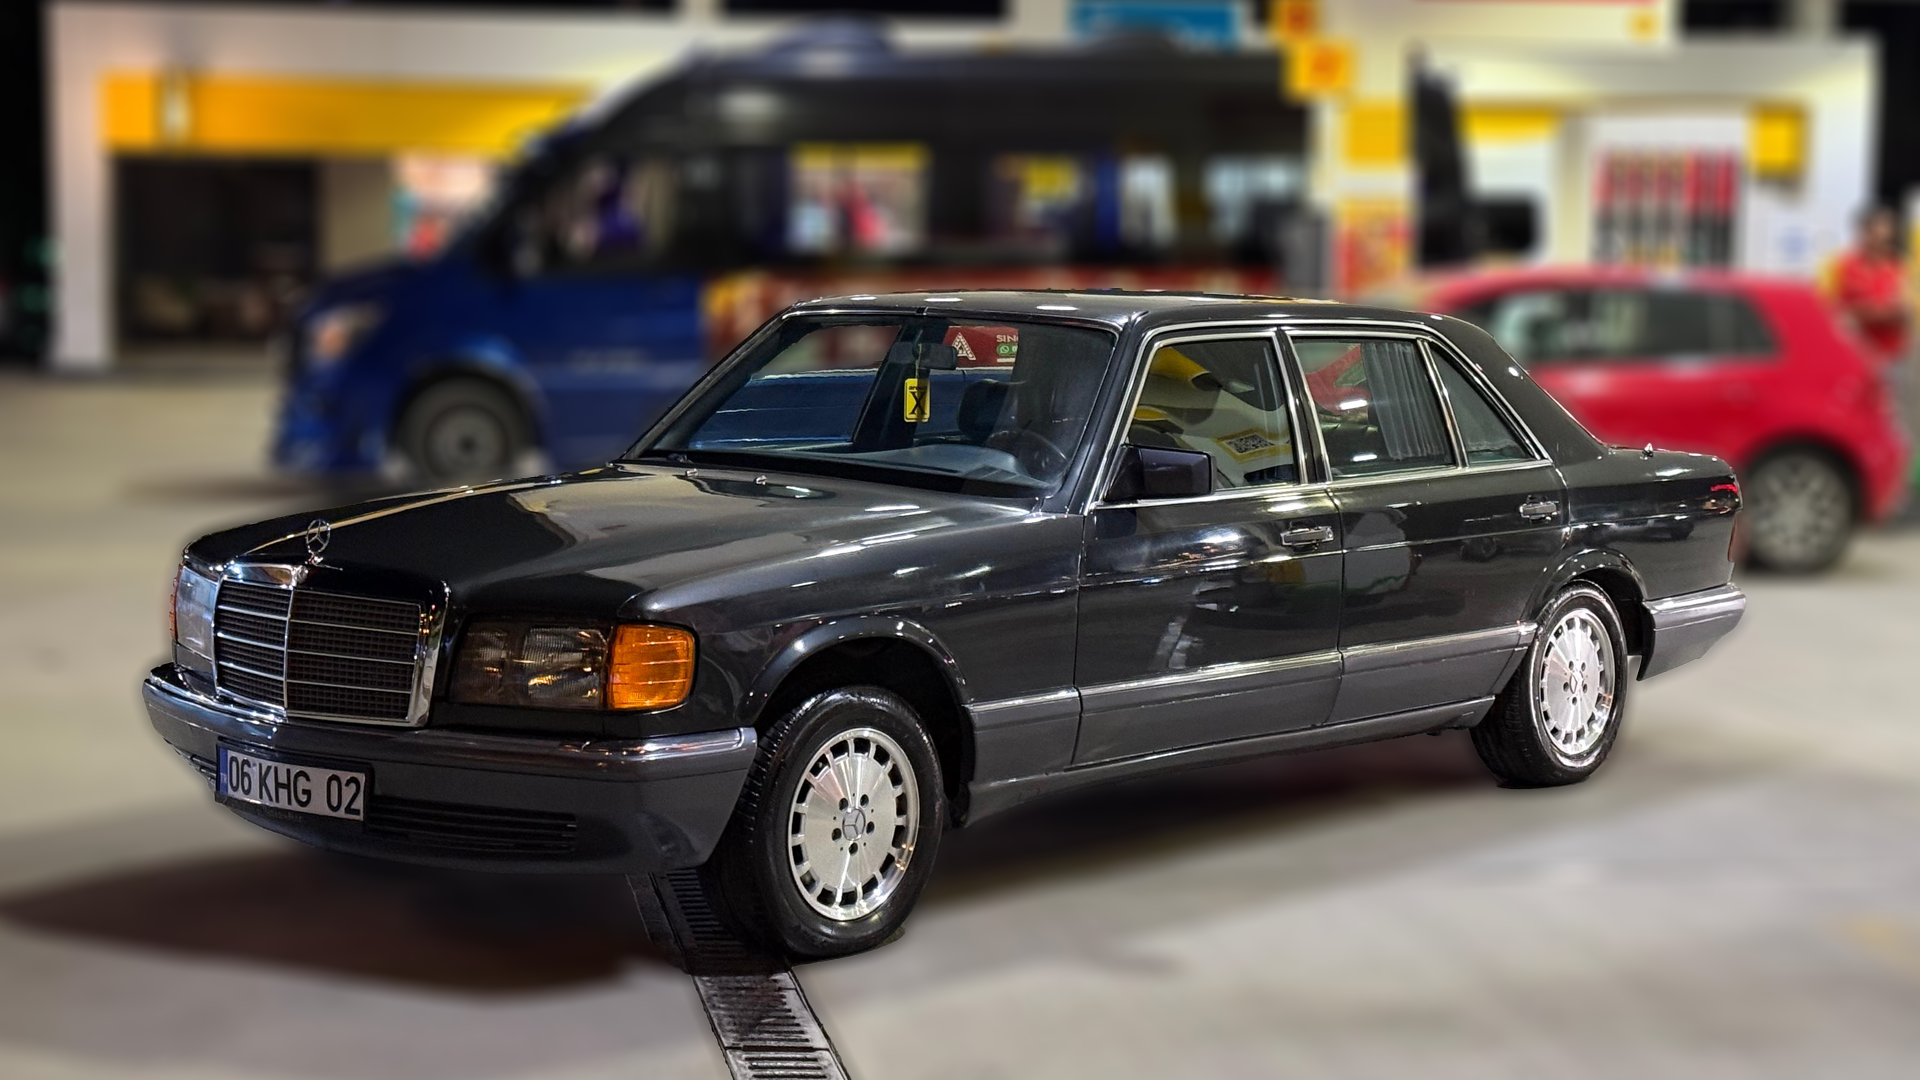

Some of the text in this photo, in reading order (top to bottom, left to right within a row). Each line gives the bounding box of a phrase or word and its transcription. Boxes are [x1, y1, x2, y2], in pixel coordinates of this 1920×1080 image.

[996, 335, 1018, 343] SIN
[909, 391, 927, 415] X
[229, 755, 361, 816] 06 KHG 02
